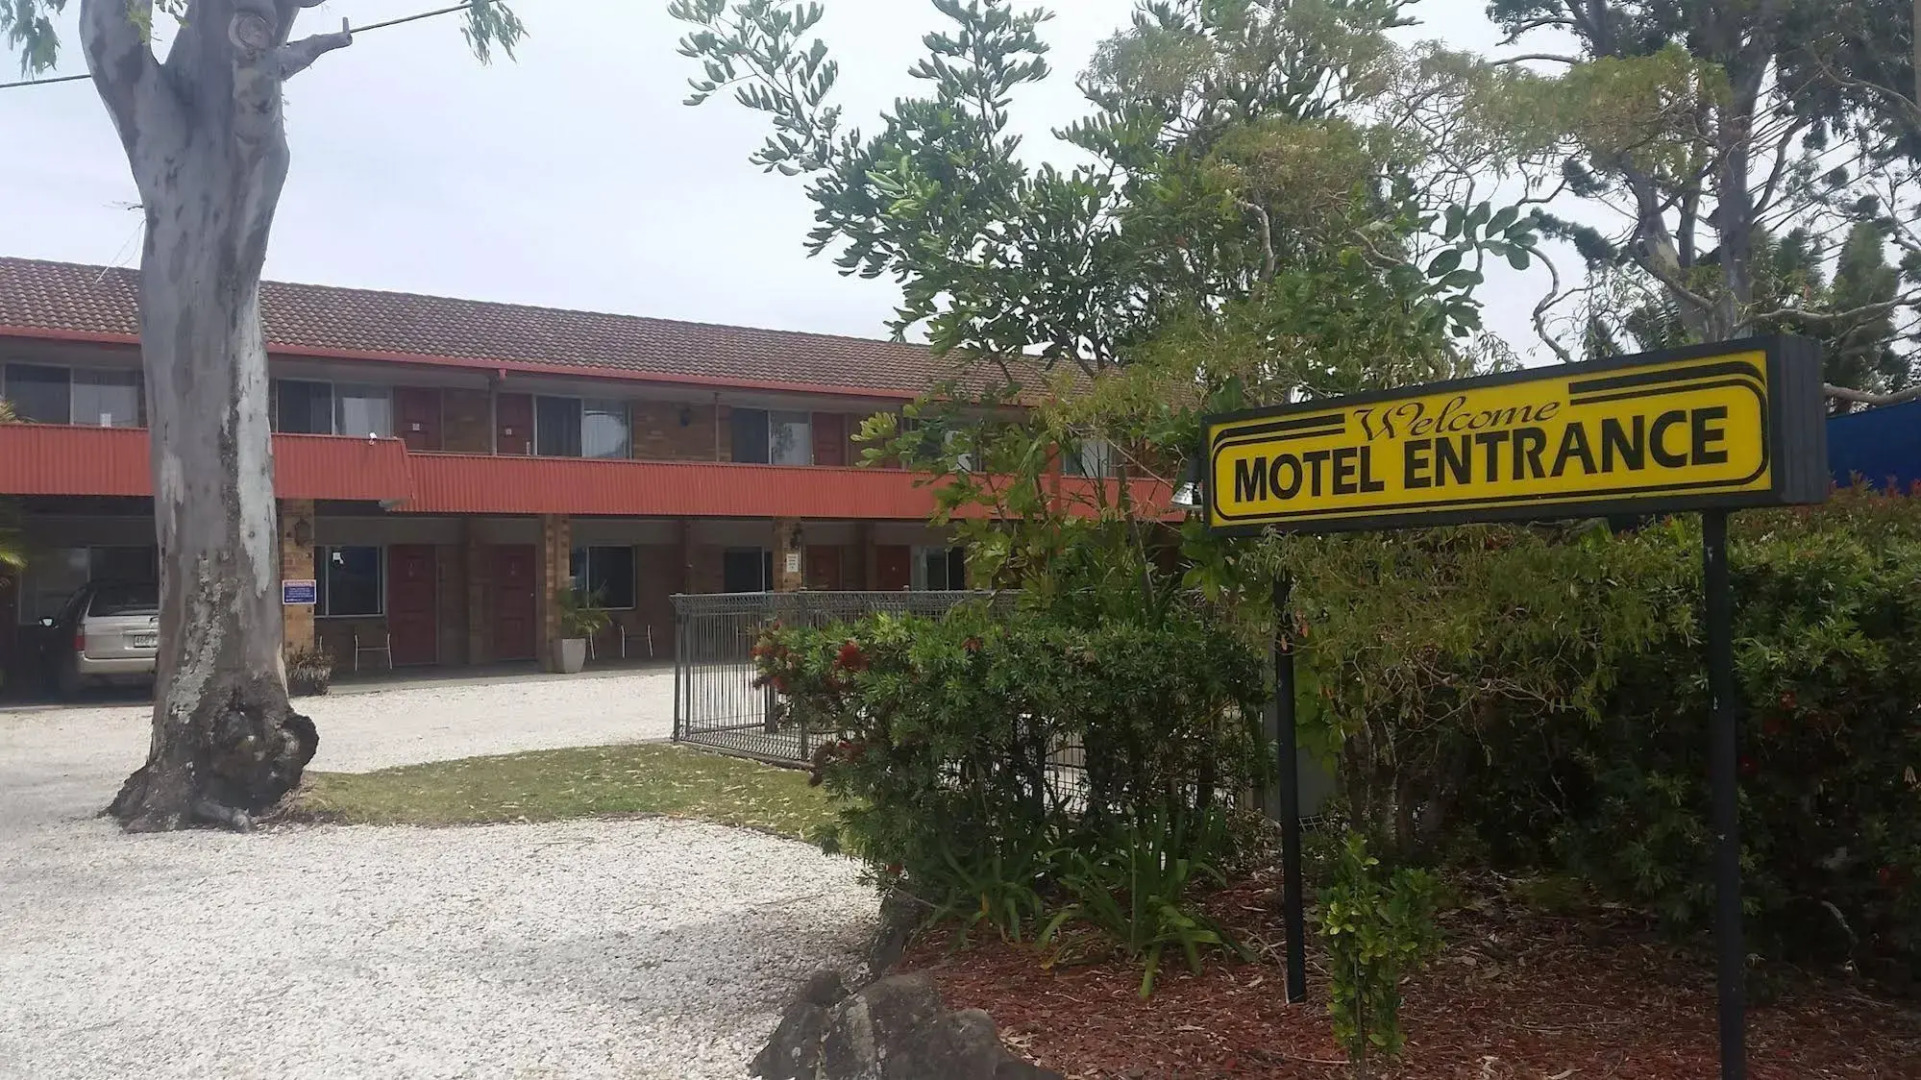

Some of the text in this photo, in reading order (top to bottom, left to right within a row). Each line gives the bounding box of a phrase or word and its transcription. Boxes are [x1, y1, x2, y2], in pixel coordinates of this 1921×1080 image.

[1354, 397, 1560, 440] Welcome
[1234, 406, 1728, 503] MOTEL ENTRANCE
